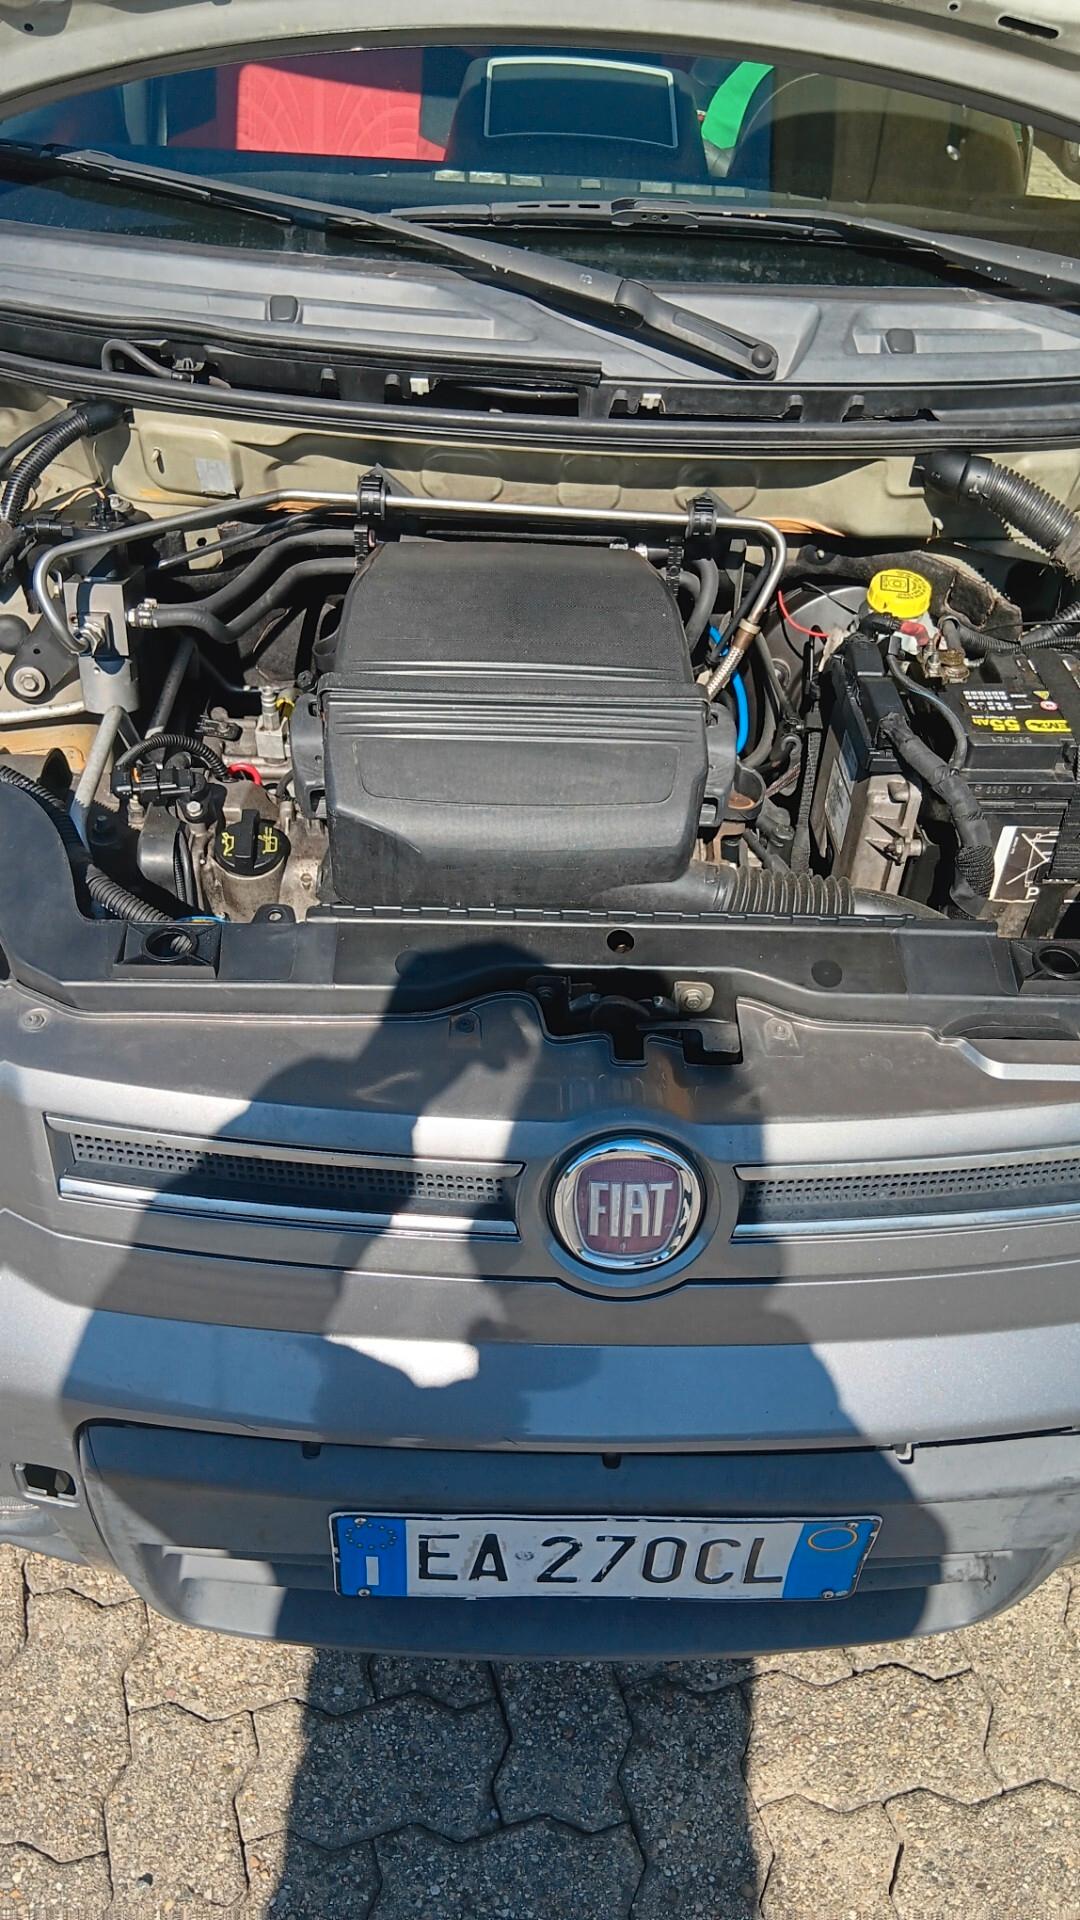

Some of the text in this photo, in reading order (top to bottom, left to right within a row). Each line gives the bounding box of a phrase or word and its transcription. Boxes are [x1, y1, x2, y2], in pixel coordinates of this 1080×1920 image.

[587, 1181, 674, 1238] FIAT
[366, 1556, 379, 1586] I
[418, 1533, 784, 1585] EA 270CL
